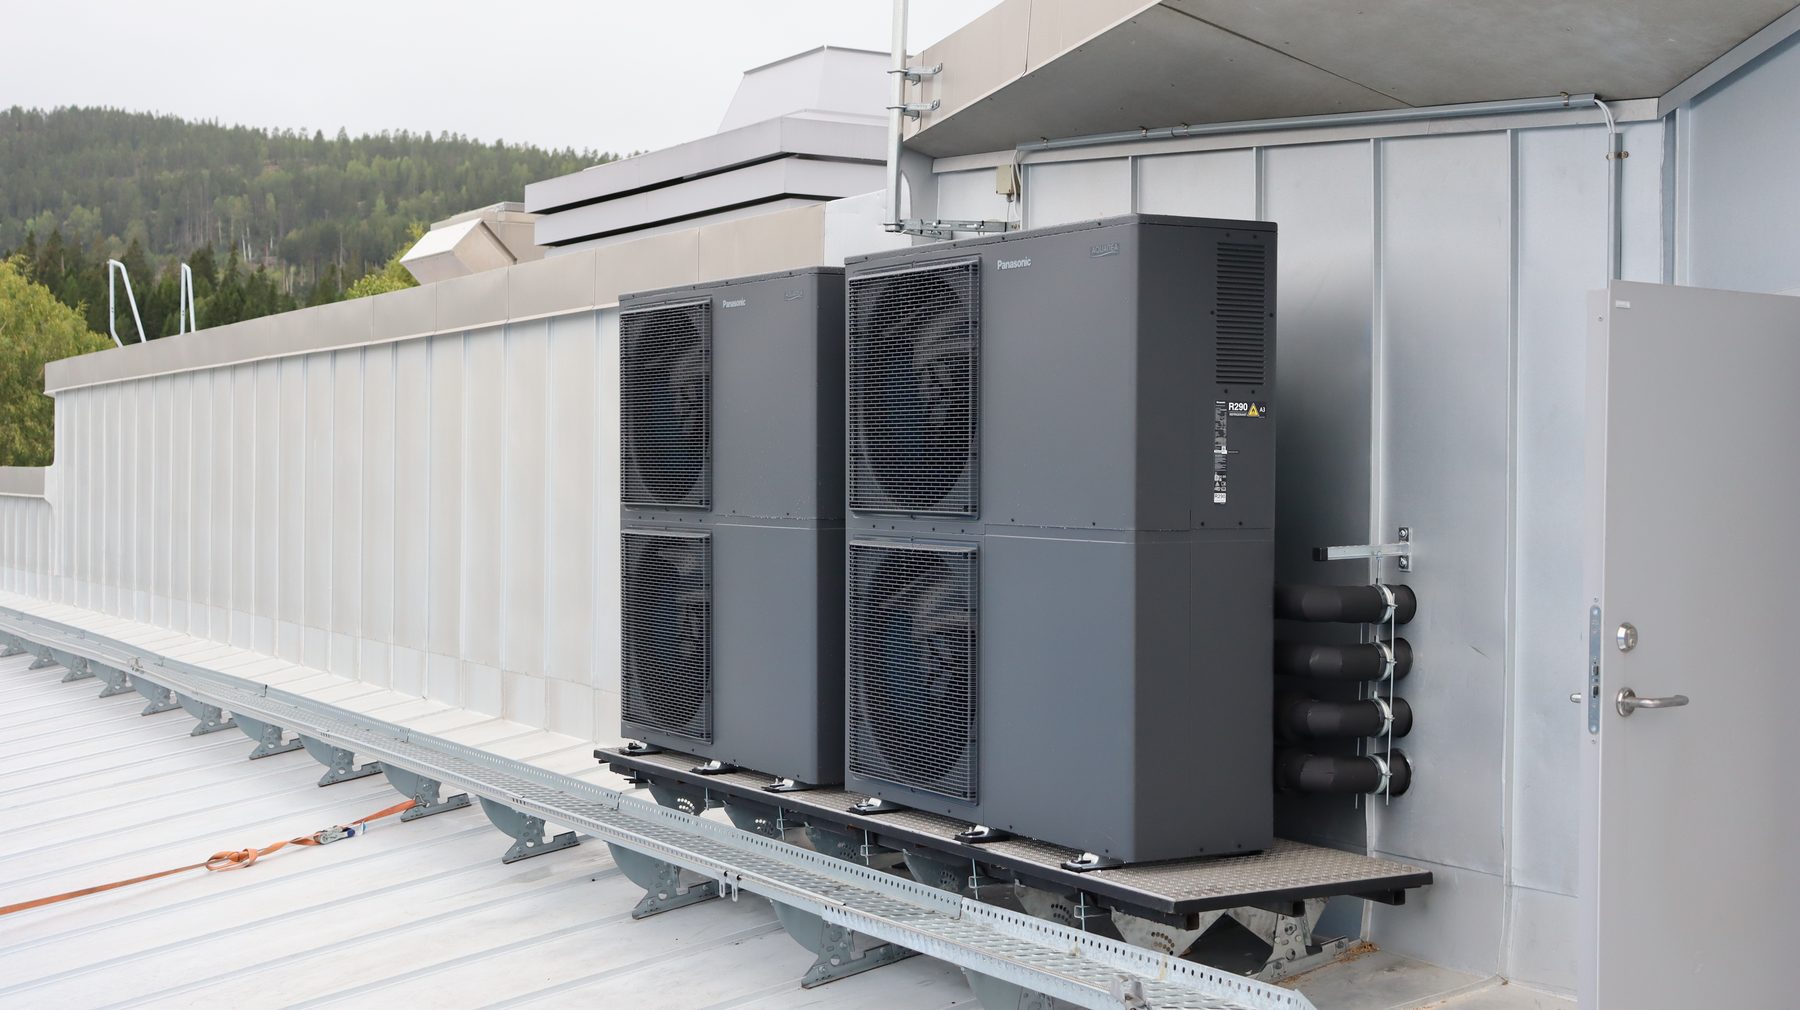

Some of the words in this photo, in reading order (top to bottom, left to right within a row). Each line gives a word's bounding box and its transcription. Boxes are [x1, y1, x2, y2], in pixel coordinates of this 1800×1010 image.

[997, 257, 1032, 270] Panasonic
[722, 297, 746, 308] Panasonic
[1228, 402, 1248, 411] R290
